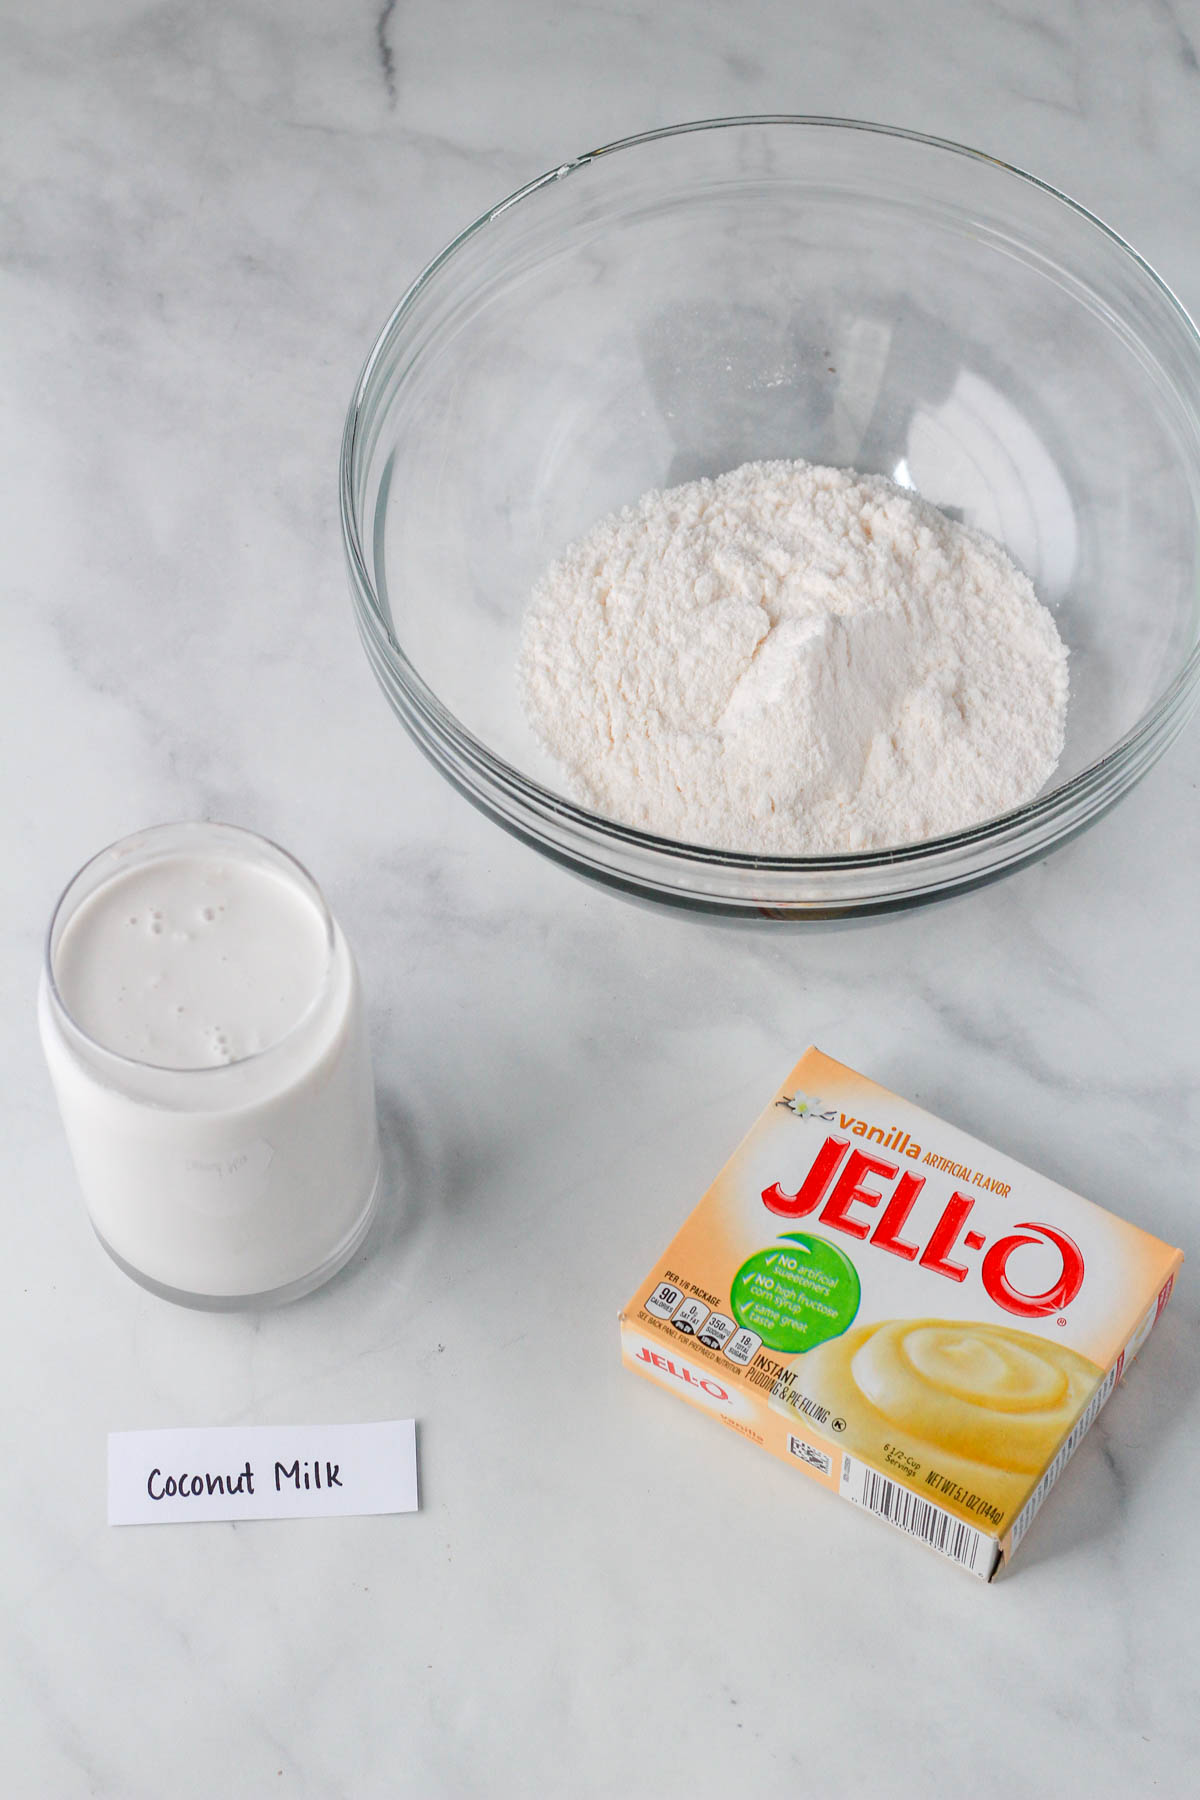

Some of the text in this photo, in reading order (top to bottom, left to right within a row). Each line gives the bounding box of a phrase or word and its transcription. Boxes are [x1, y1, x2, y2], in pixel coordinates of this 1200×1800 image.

[840, 1112, 922, 1160] vanilla
[922, 1152, 1012, 1198] ARTIFICIAL FLAVOR
[774, 1265, 831, 1296] sweeteners
[778, 1255, 839, 1288] NO artificial
[659, 1287, 677, 1304] 90
[664, 1270, 721, 1307] PER 1/6 PACKAGE
[750, 1285, 802, 1315] corn syrup
[754, 1273, 839, 1319] NO high fructose
[650, 1296, 674, 1314] CALORIES
[750, 1311, 775, 1329] taste
[754, 1303, 808, 1334] same great
[715, 1353, 742, 1375] NUTRITION
[753, 1354, 798, 1386] INSTANT
[745, 1366, 831, 1424] PUDDING & PIE FILLING
[883, 1444, 921, 1470] 6 1/2-Cup
[885, 1455, 916, 1477] Servings
[147, 1460, 343, 1500] Coconut Milk
[925, 1470, 1005, 1526] NET WT 5.1 OZ (144g)
